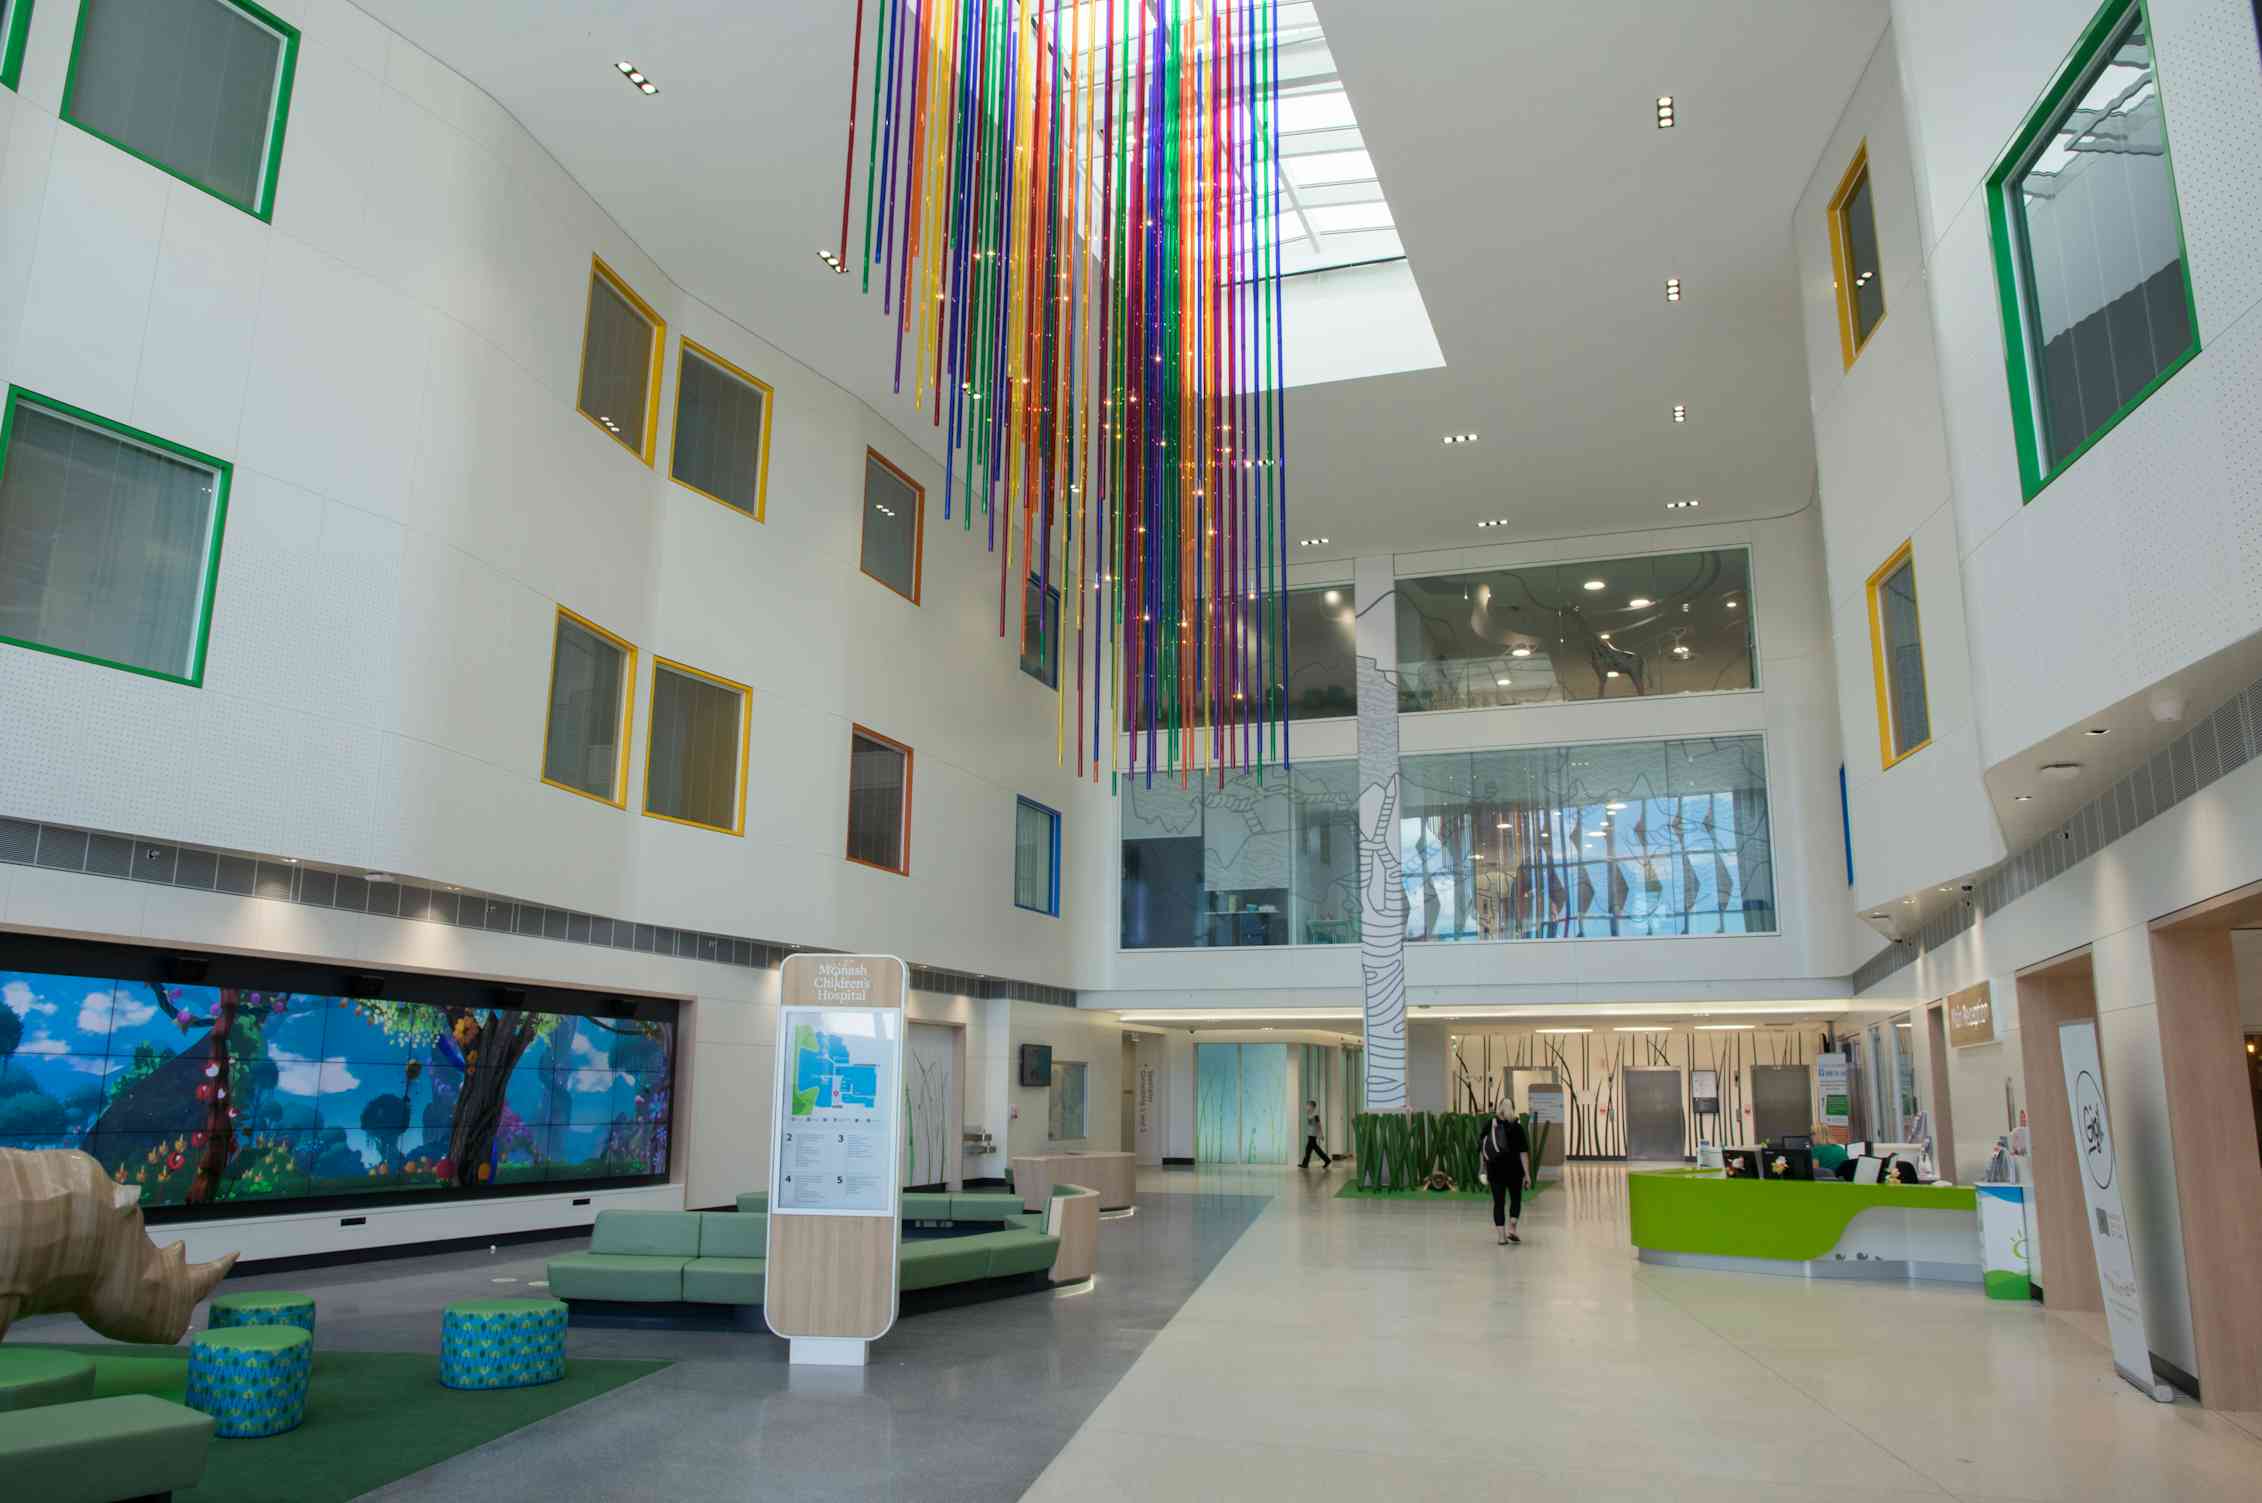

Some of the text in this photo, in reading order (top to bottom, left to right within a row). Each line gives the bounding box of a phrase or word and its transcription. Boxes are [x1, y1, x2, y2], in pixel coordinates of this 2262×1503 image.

[817, 989, 867, 1004] Hospital
[786, 1133, 793, 1141] 2
[838, 1134, 844, 1143] 3
[785, 1175, 791, 1183] 4
[836, 1175, 843, 1184] 5
